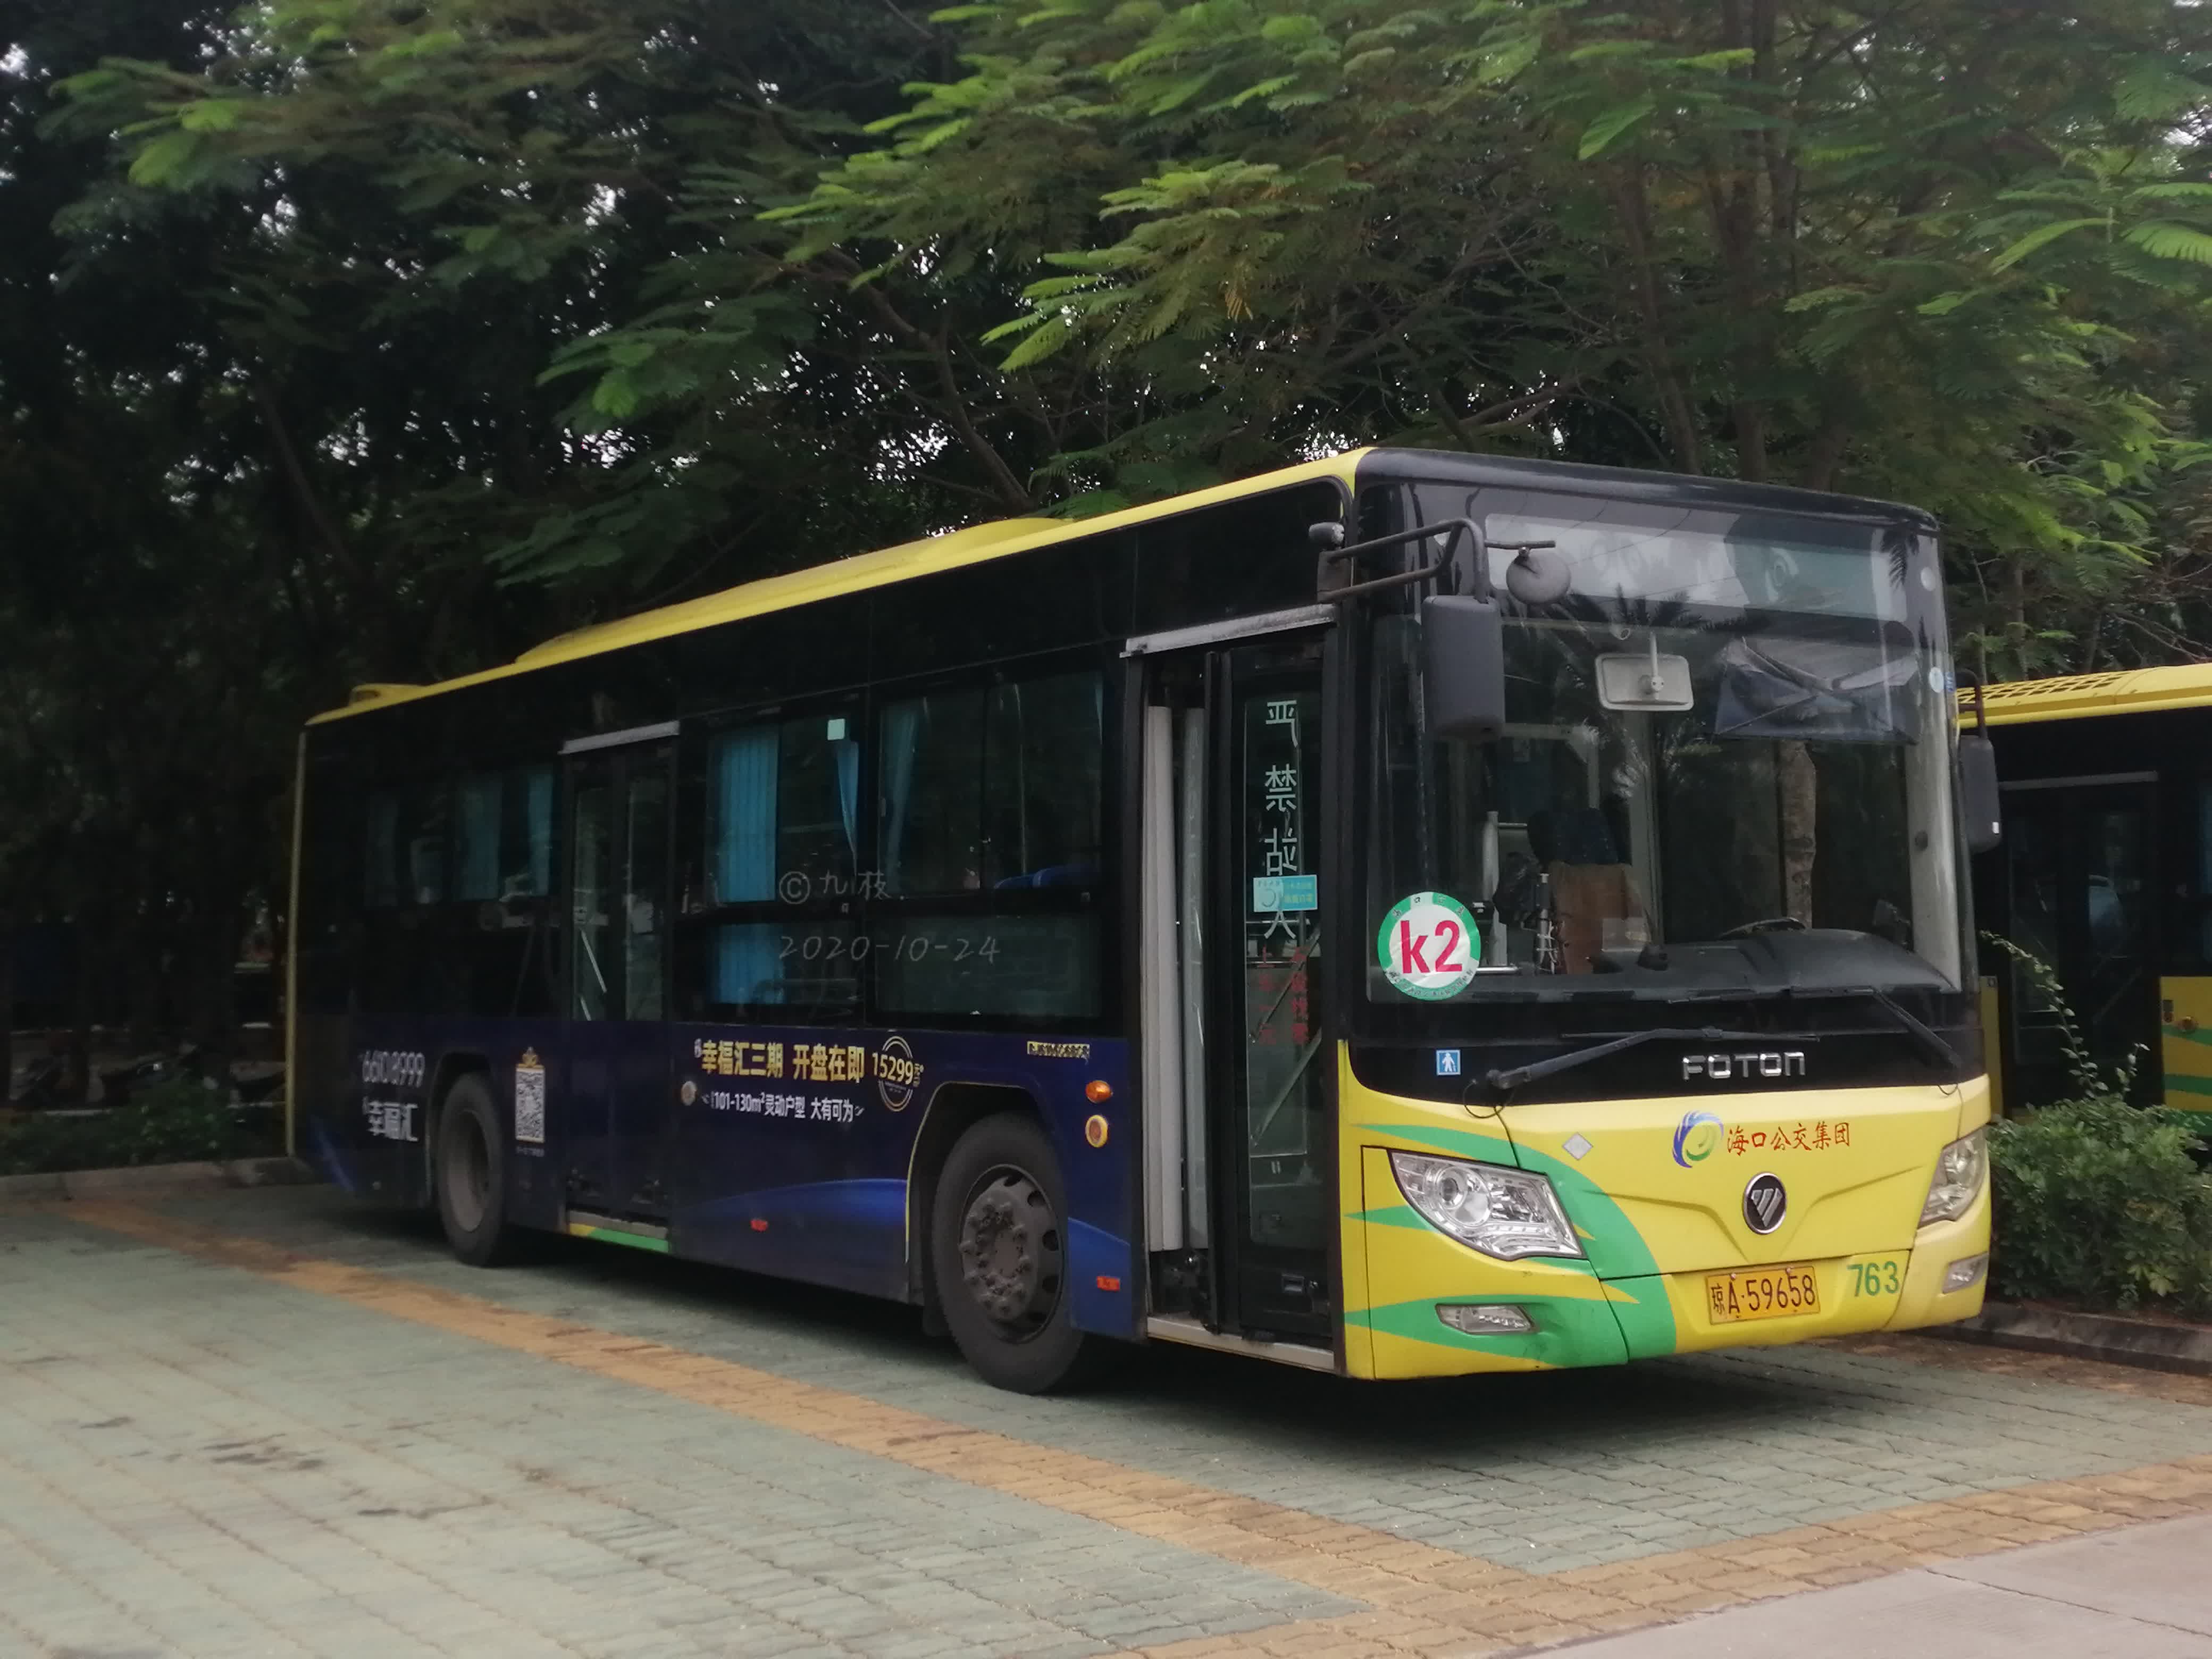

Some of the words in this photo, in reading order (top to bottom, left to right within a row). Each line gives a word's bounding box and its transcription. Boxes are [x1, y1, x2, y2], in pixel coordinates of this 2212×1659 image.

[1400, 920, 1463, 974] k2
[793, 1044, 865, 1083] 开盘在即
[872, 1052, 914, 1085] 15299
[1681, 1051, 1806, 1081] FOTON
[811, 1097, 854, 1122] 大有可为
[1727, 1121, 1850, 1155] 海口公交集团
[1847, 1261, 1900, 1297] 763
